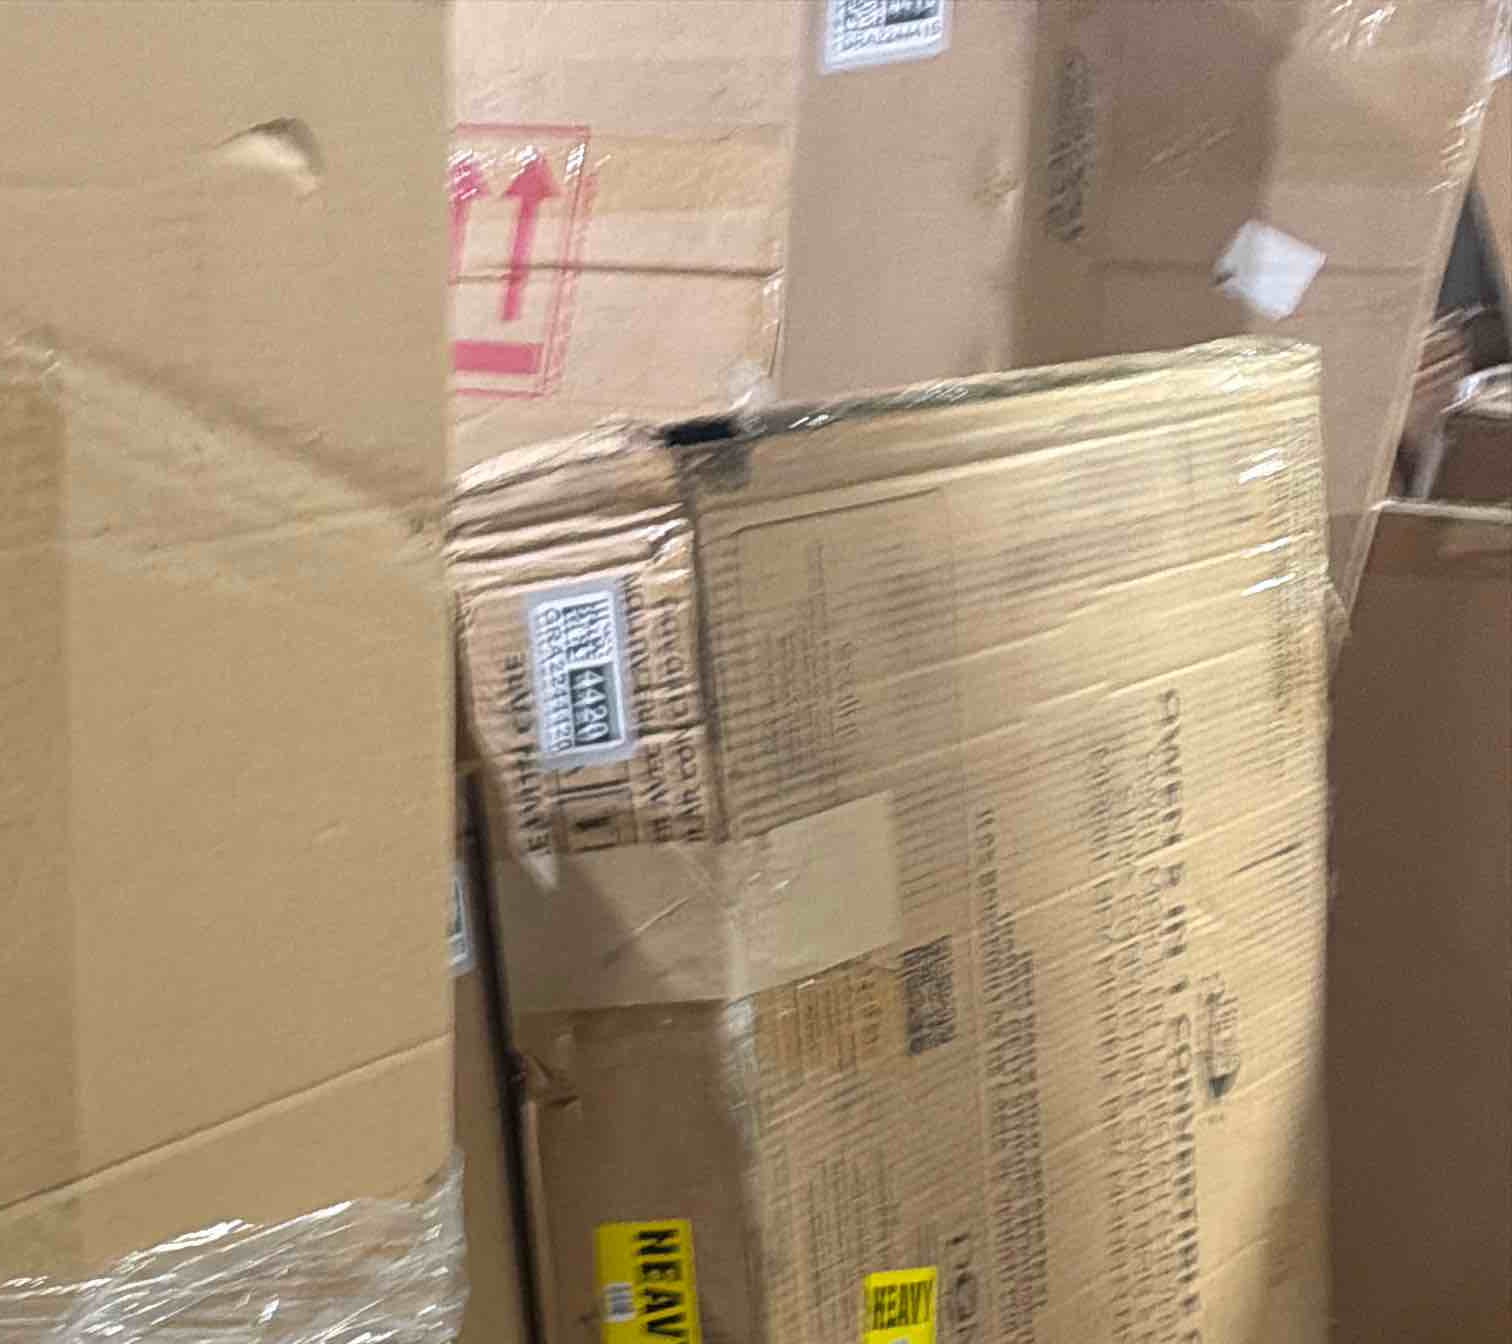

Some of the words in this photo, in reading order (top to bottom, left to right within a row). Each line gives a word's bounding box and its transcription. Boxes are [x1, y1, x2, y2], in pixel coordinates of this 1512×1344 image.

[575, 667, 609, 744] 4420
[1168, 1013, 1200, 1314] CONVERTIBLE
[872, 1277, 937, 1332] HEAVY
